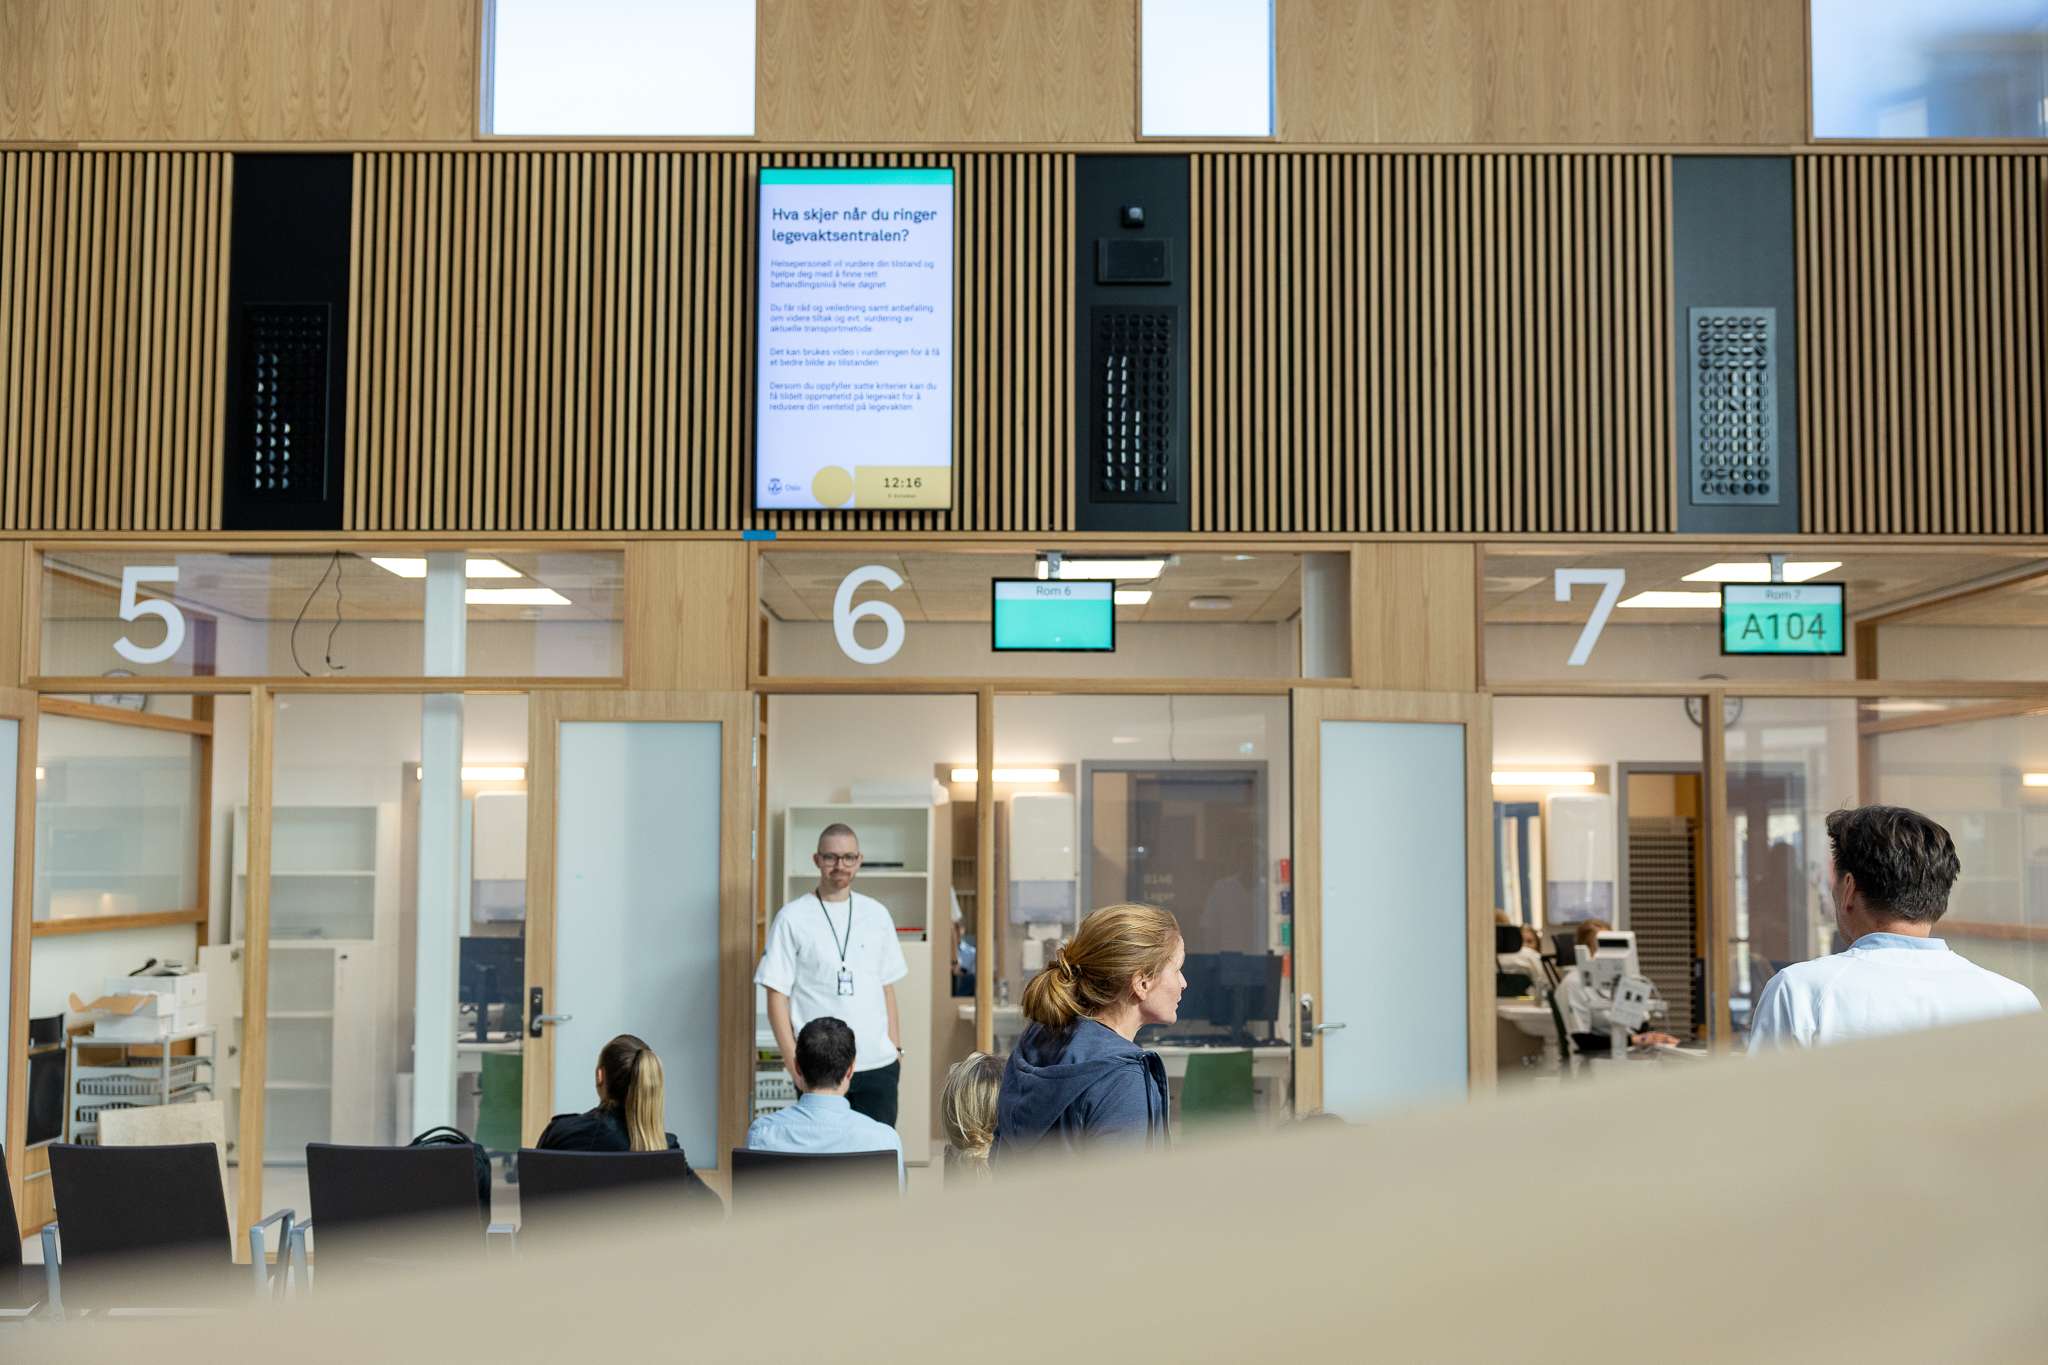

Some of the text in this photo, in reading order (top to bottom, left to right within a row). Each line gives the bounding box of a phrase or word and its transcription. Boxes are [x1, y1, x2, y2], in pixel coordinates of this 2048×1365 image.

[772, 208, 937, 223] Hva skjer når du ringer
[772, 229, 910, 244] legevaktsentralen?
[883, 477, 922, 488] 12:16
[1036, 586, 1071, 596] Rom 6
[1765, 590, 1800, 600] Rom 7
[113, 566, 186, 663] 5
[833, 564, 905, 664] 6
[1553, 568, 1626, 666] 7
[1741, 612, 1826, 640] A104
